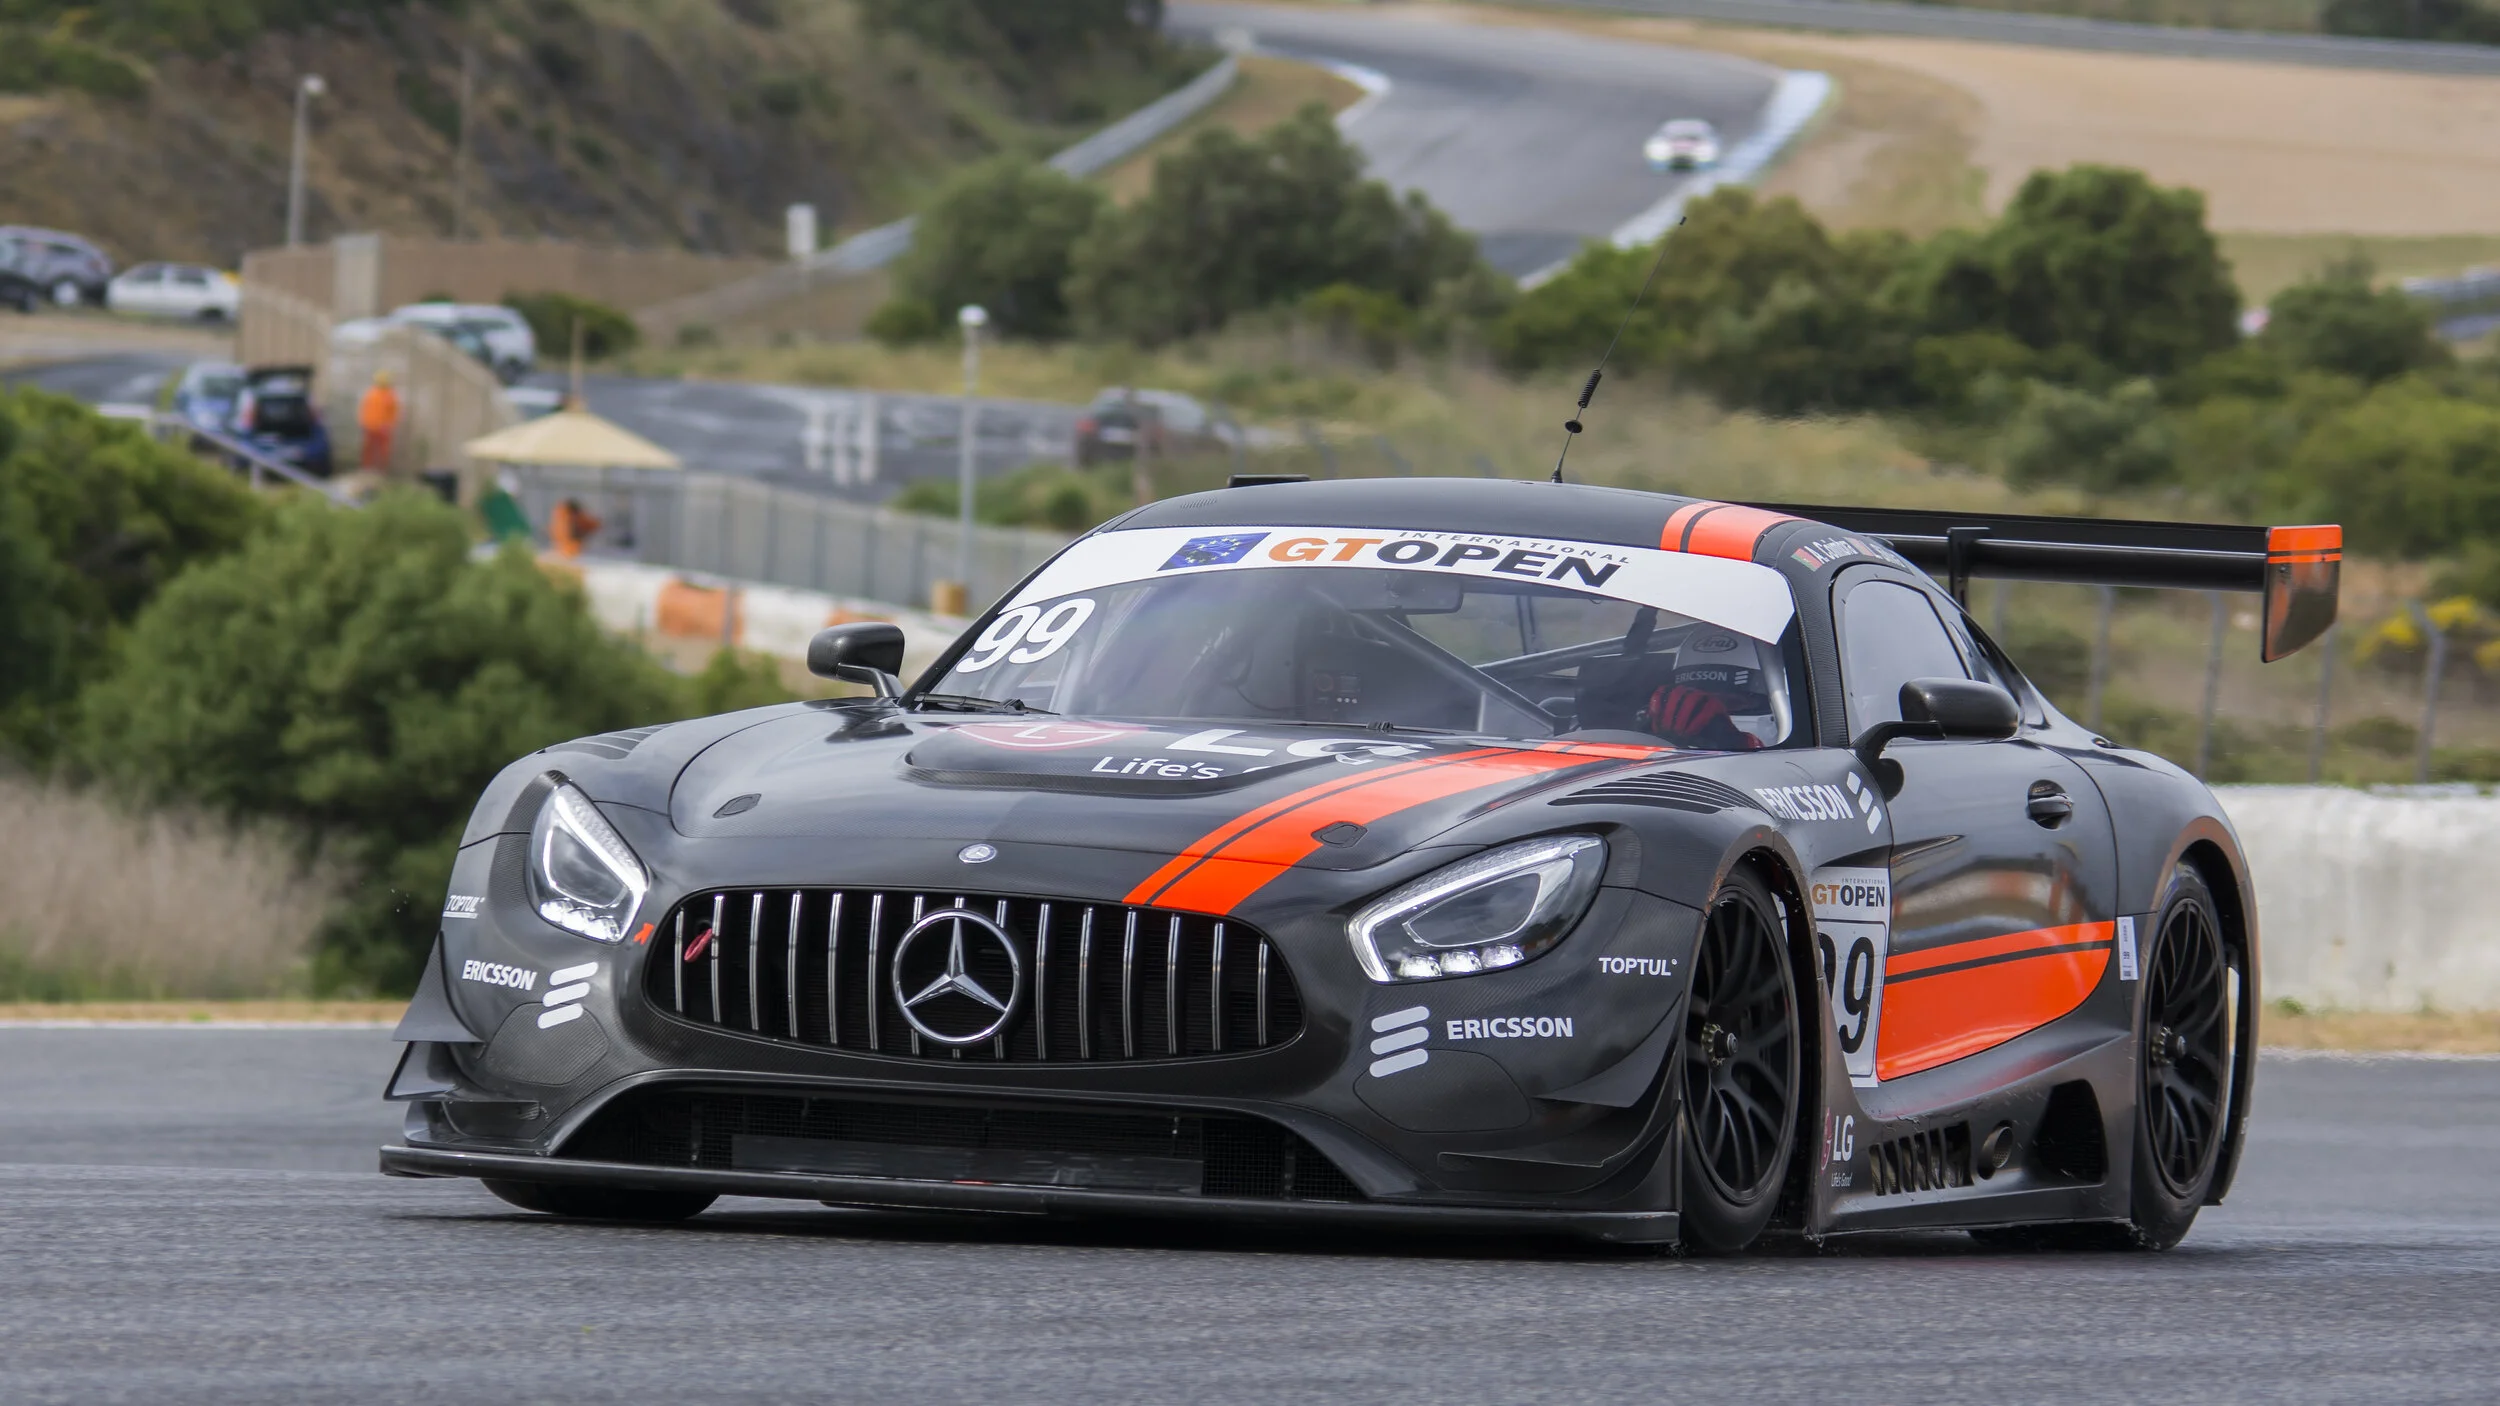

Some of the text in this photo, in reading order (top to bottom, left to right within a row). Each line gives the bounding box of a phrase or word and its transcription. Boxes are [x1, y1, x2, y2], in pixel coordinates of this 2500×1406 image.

[1399, 531, 1630, 564] INTERNATIONAL
[956, 598, 1096, 673] 99
[1675, 671, 1728, 684] ERICSSON
[1091, 756, 1224, 780] Life's
[1754, 784, 1854, 820] ERICSSON
[462, 960, 537, 991] ERICSSON
[1447, 1017, 1573, 1040] ERICSSON
[1833, 1115, 1854, 1161] LG
